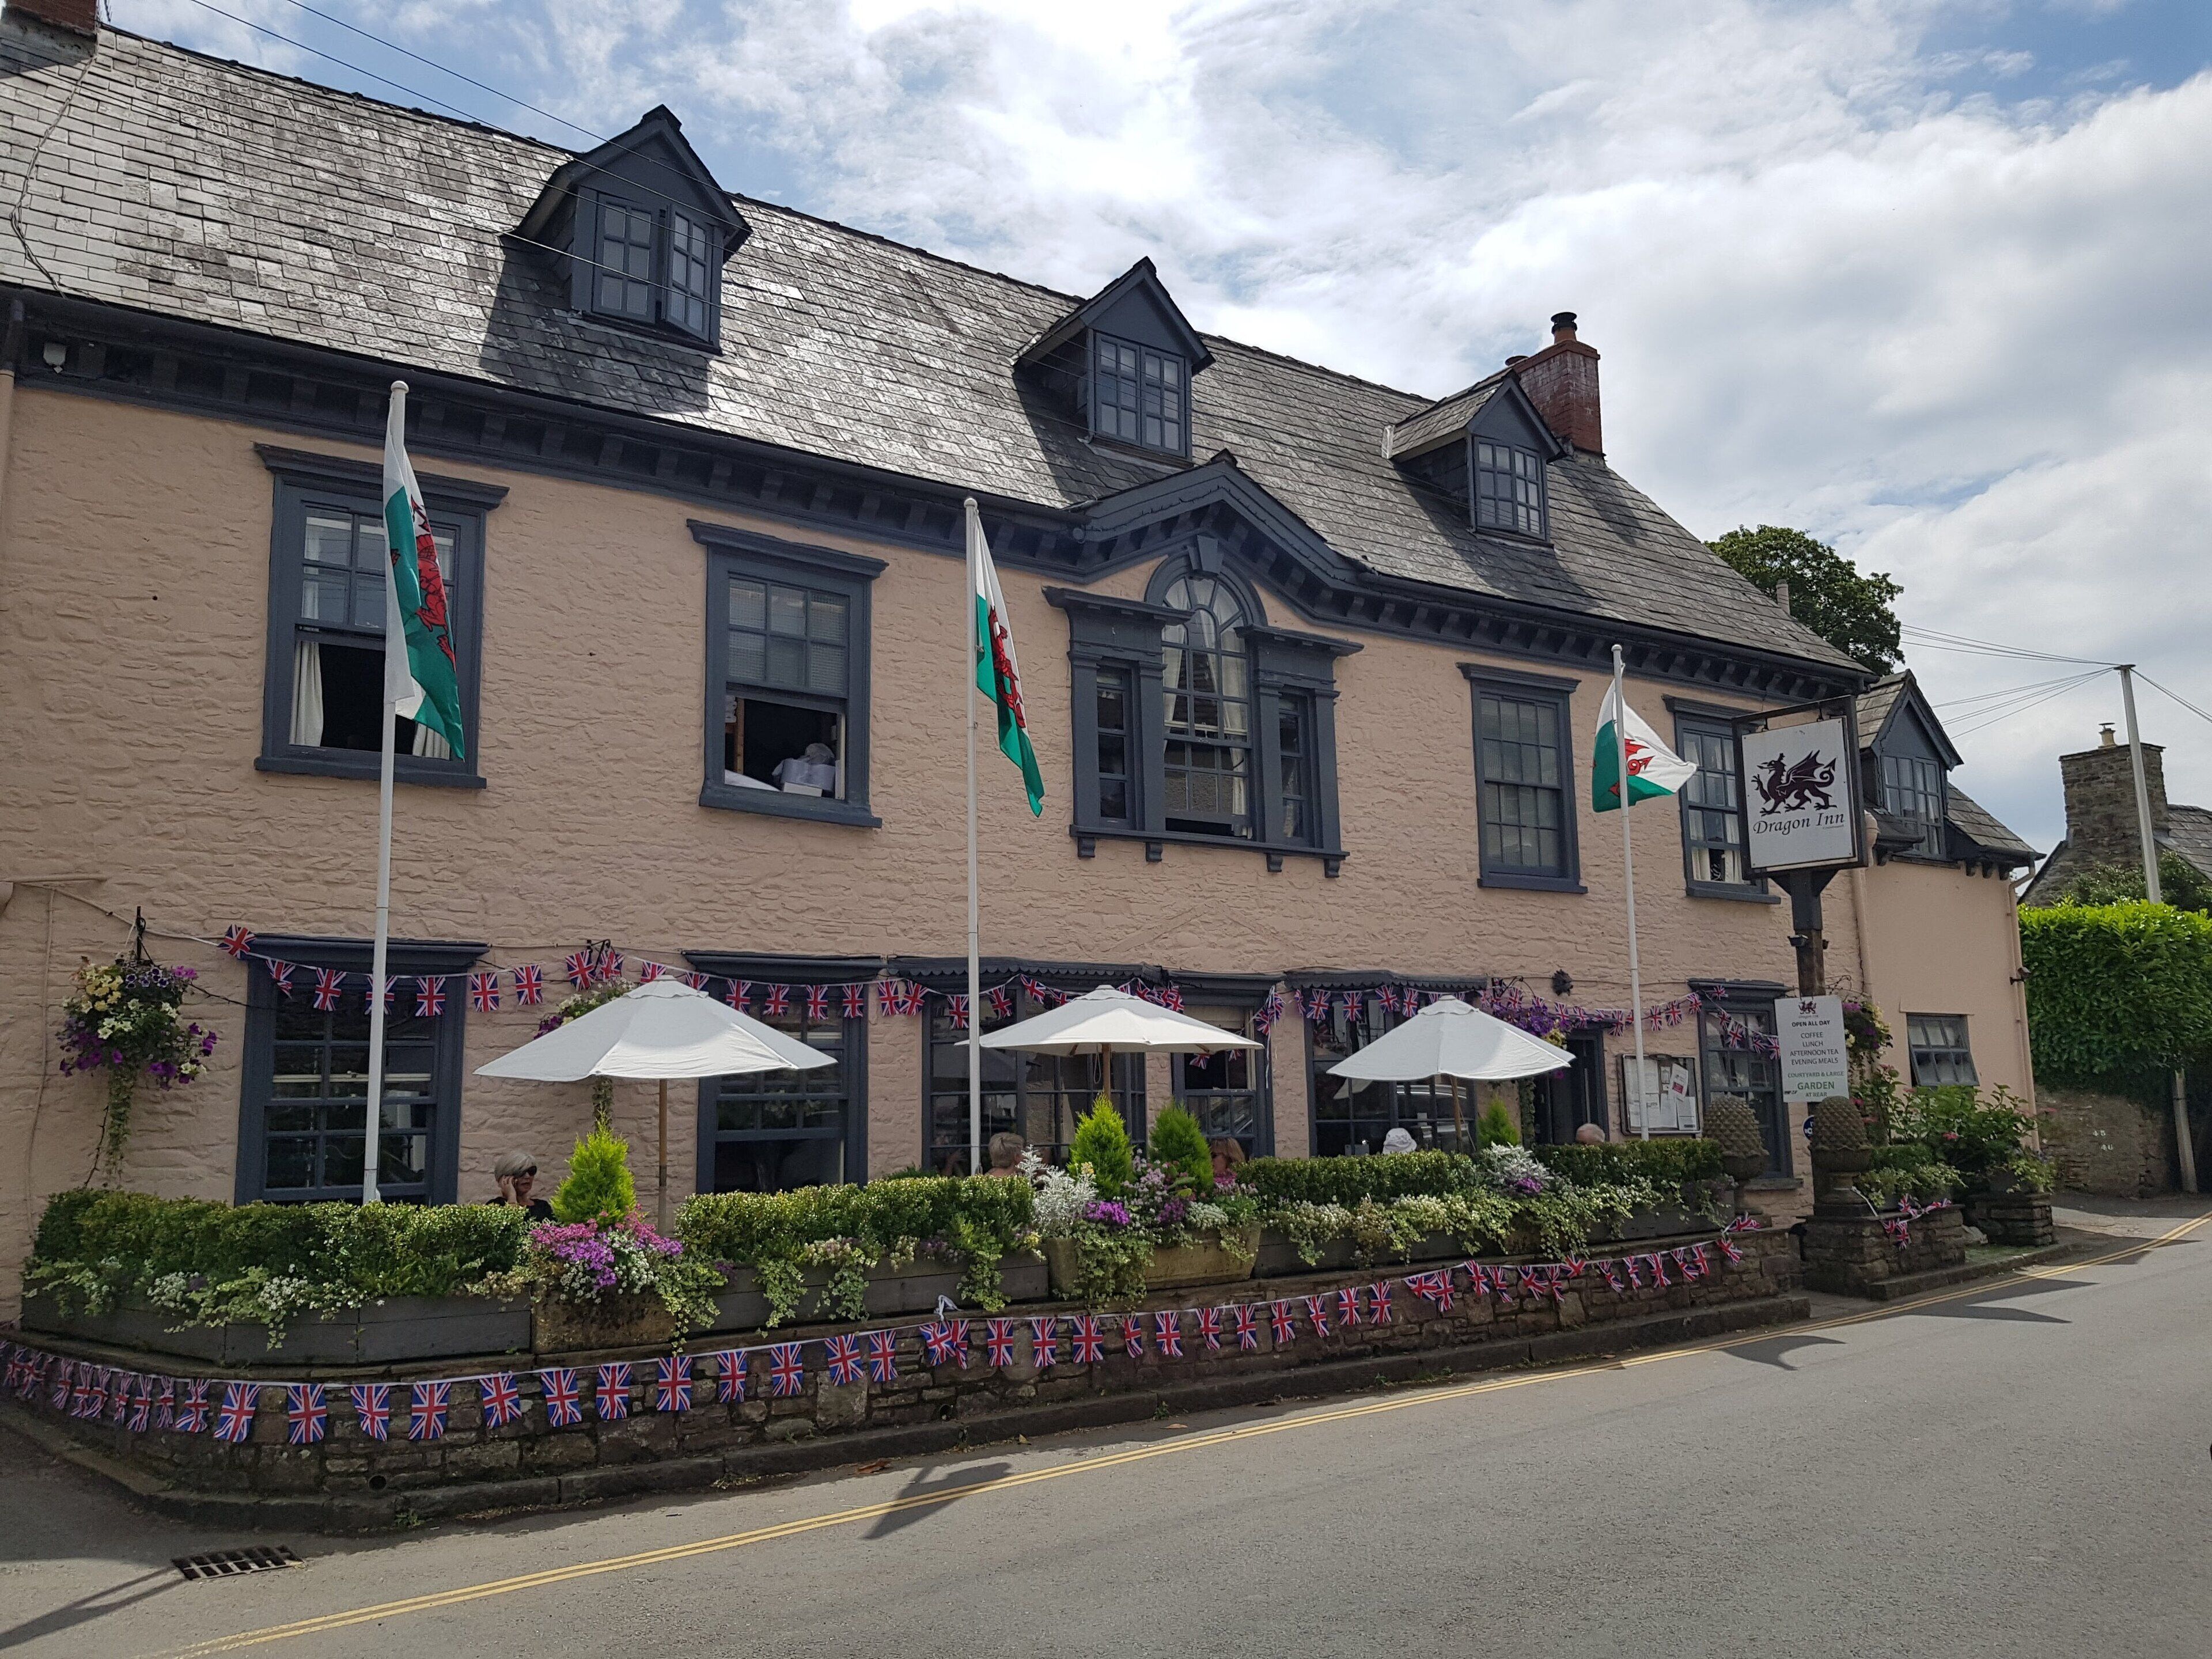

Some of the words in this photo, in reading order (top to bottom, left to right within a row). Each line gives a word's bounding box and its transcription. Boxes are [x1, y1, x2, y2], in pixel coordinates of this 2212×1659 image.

[1753, 817, 1810, 835] Dragon
[1816, 813, 1844, 826] Inn
[1797, 1081, 1835, 1090] GARDEN
